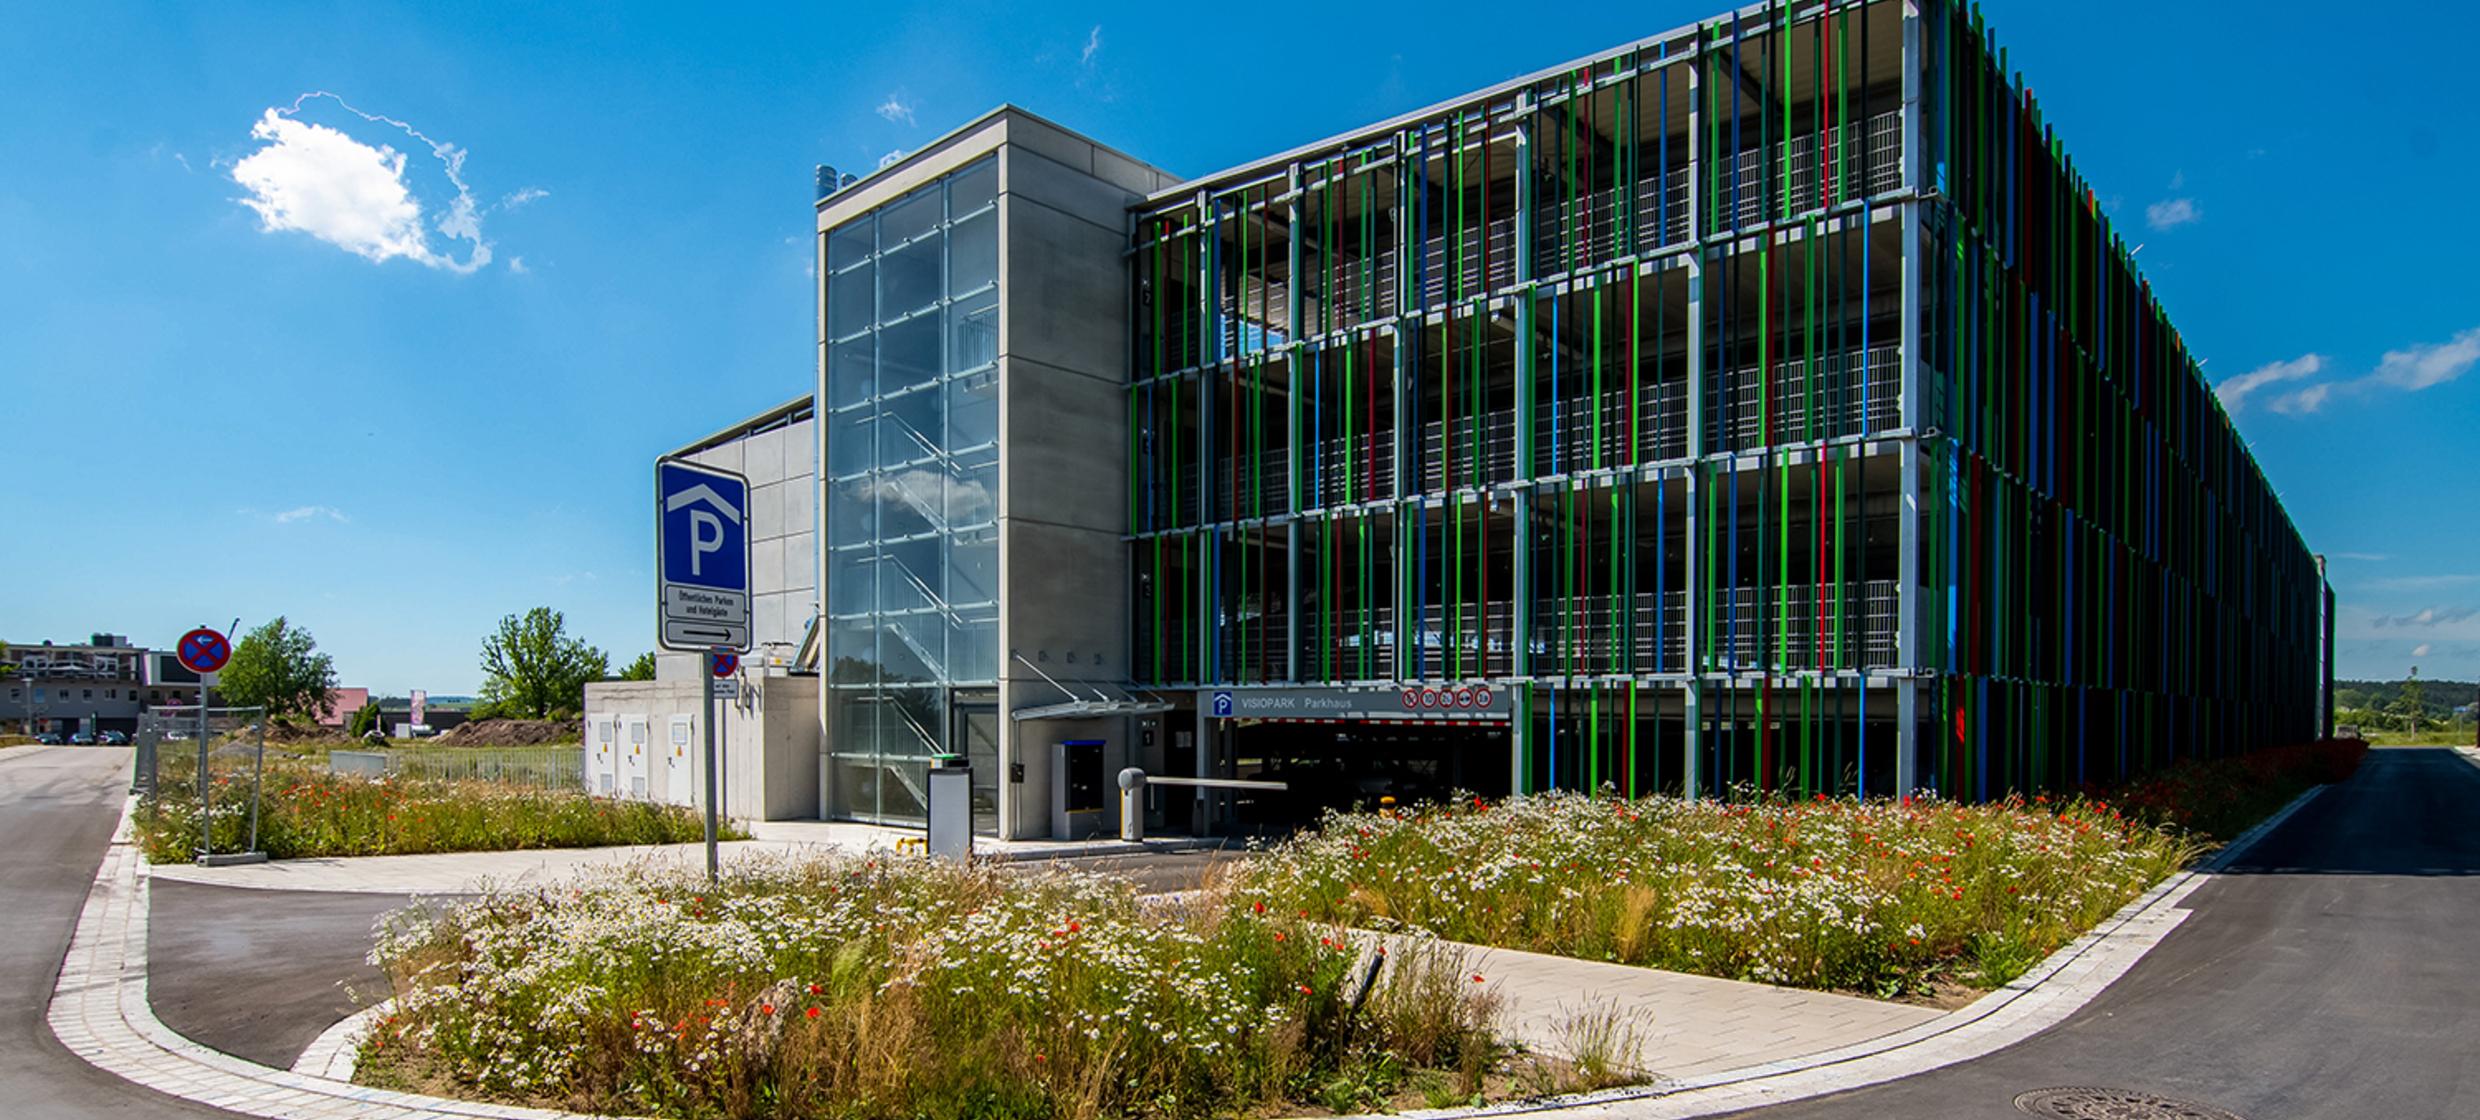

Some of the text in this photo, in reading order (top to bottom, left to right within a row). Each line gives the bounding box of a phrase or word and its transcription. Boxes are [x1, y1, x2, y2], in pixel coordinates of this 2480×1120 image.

[690, 509, 724, 576] P
[1218, 697, 1352, 713] P VISIOPARK Parkhaus
